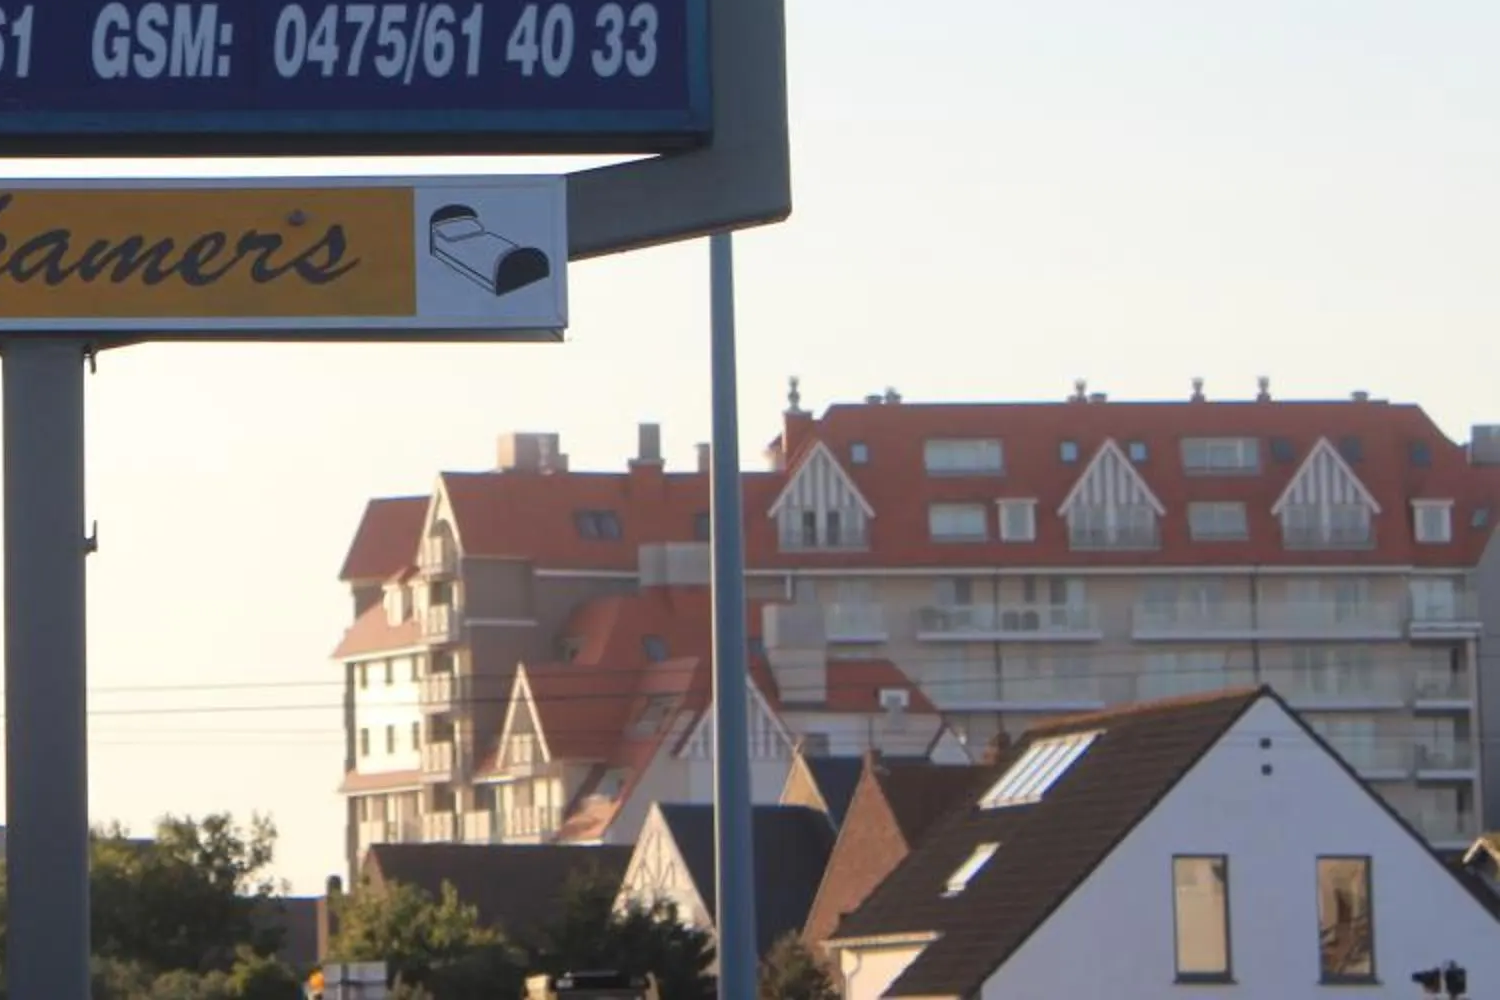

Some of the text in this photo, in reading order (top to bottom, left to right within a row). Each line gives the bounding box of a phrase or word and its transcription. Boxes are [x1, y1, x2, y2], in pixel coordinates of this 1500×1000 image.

[91, 2, 233, 79] GSM:
[274, 2, 484, 85] 0475/61
[506, 3, 575, 78] 40
[591, 2, 659, 78] 33
